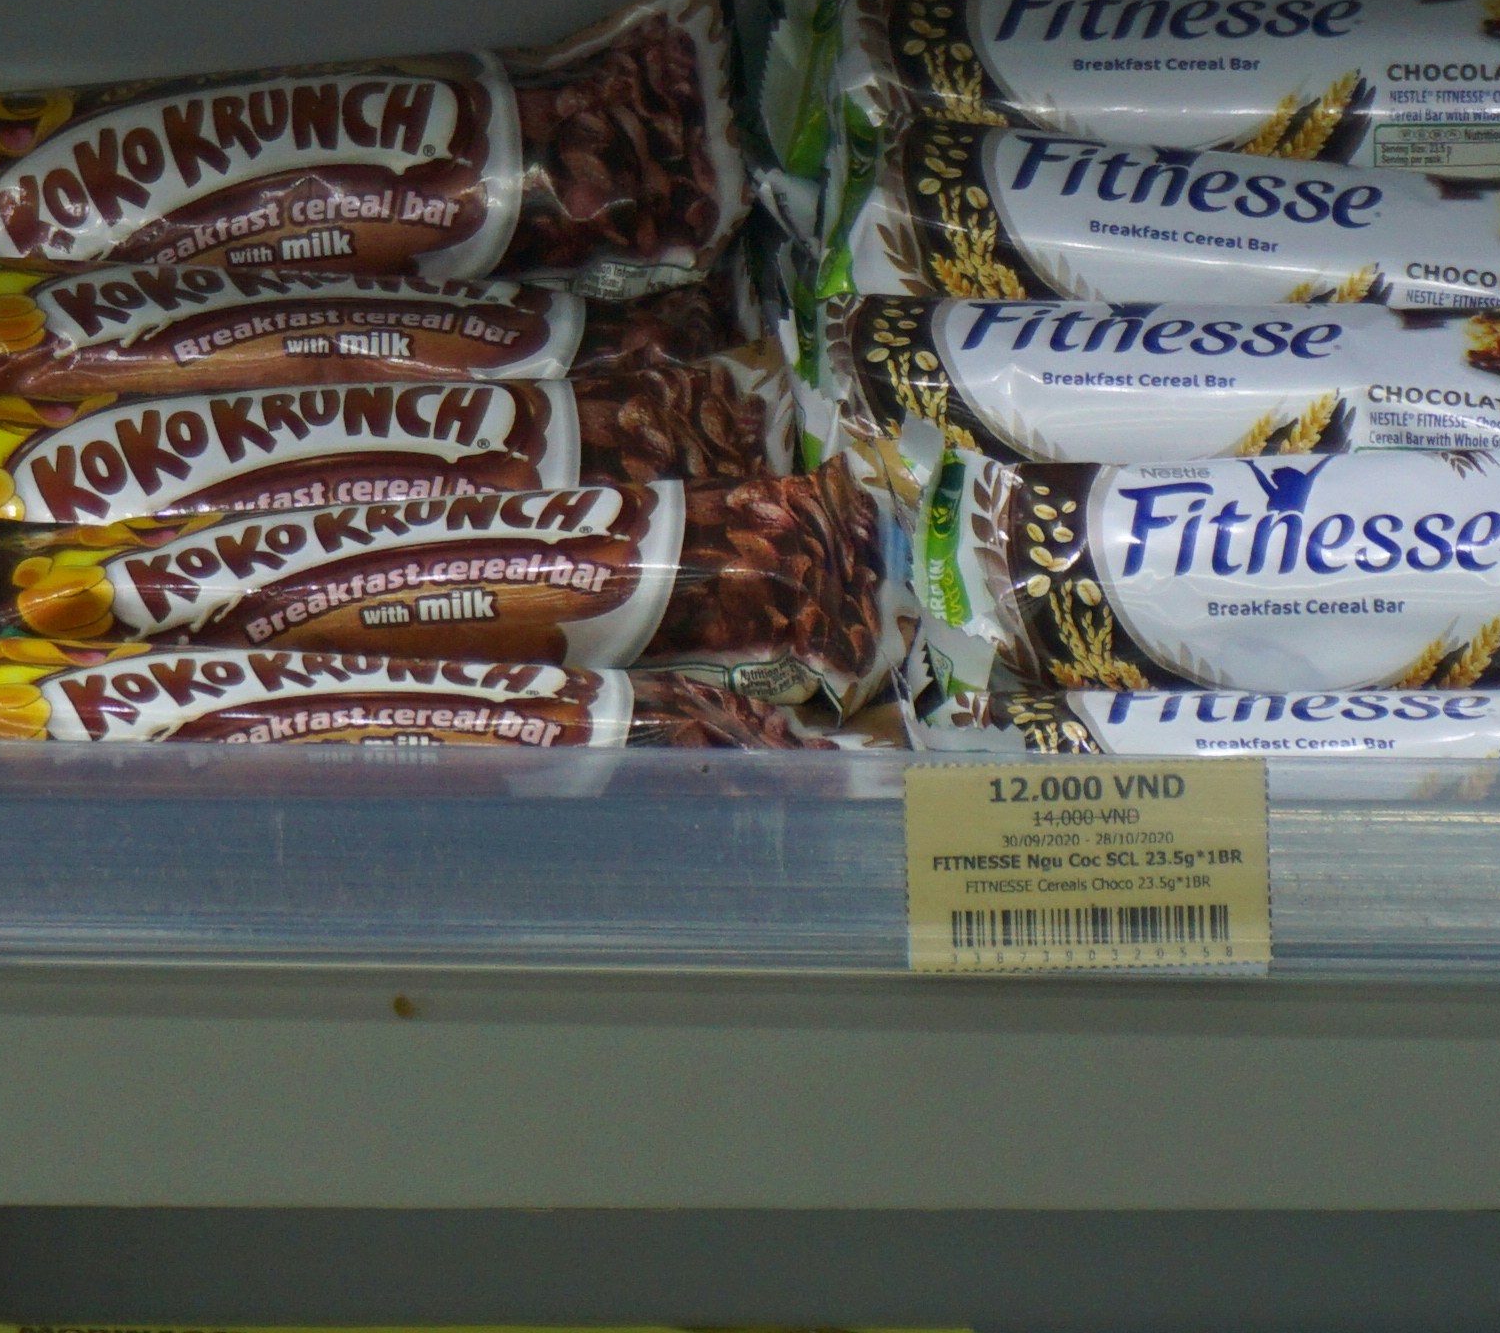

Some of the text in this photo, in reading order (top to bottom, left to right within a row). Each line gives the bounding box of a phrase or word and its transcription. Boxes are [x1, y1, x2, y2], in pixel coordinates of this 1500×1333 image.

[162, 79, 440, 185] KRUNCH
[1010, 135, 1384, 231] Fitnesse
[29, 385, 500, 527] KOKO KRUNCH
[122, 486, 595, 625] KOKO KRUNCH
[246, 553, 613, 646] Breakfast cereal bar
[362, 588, 495, 627] with milk
[1207, 597, 1405, 618] Breakfast Cereal Bar
[989, 773, 1187, 803] 12.000 VND
[933, 854, 1022, 872] FITNESSE
[1027, 853, 1063, 873] Ngu
[1068, 852, 1101, 869] Coc
[1106, 851, 1140, 868] SCL
[1001, 831, 1174, 849] 30/09/2020 28/10/2020
